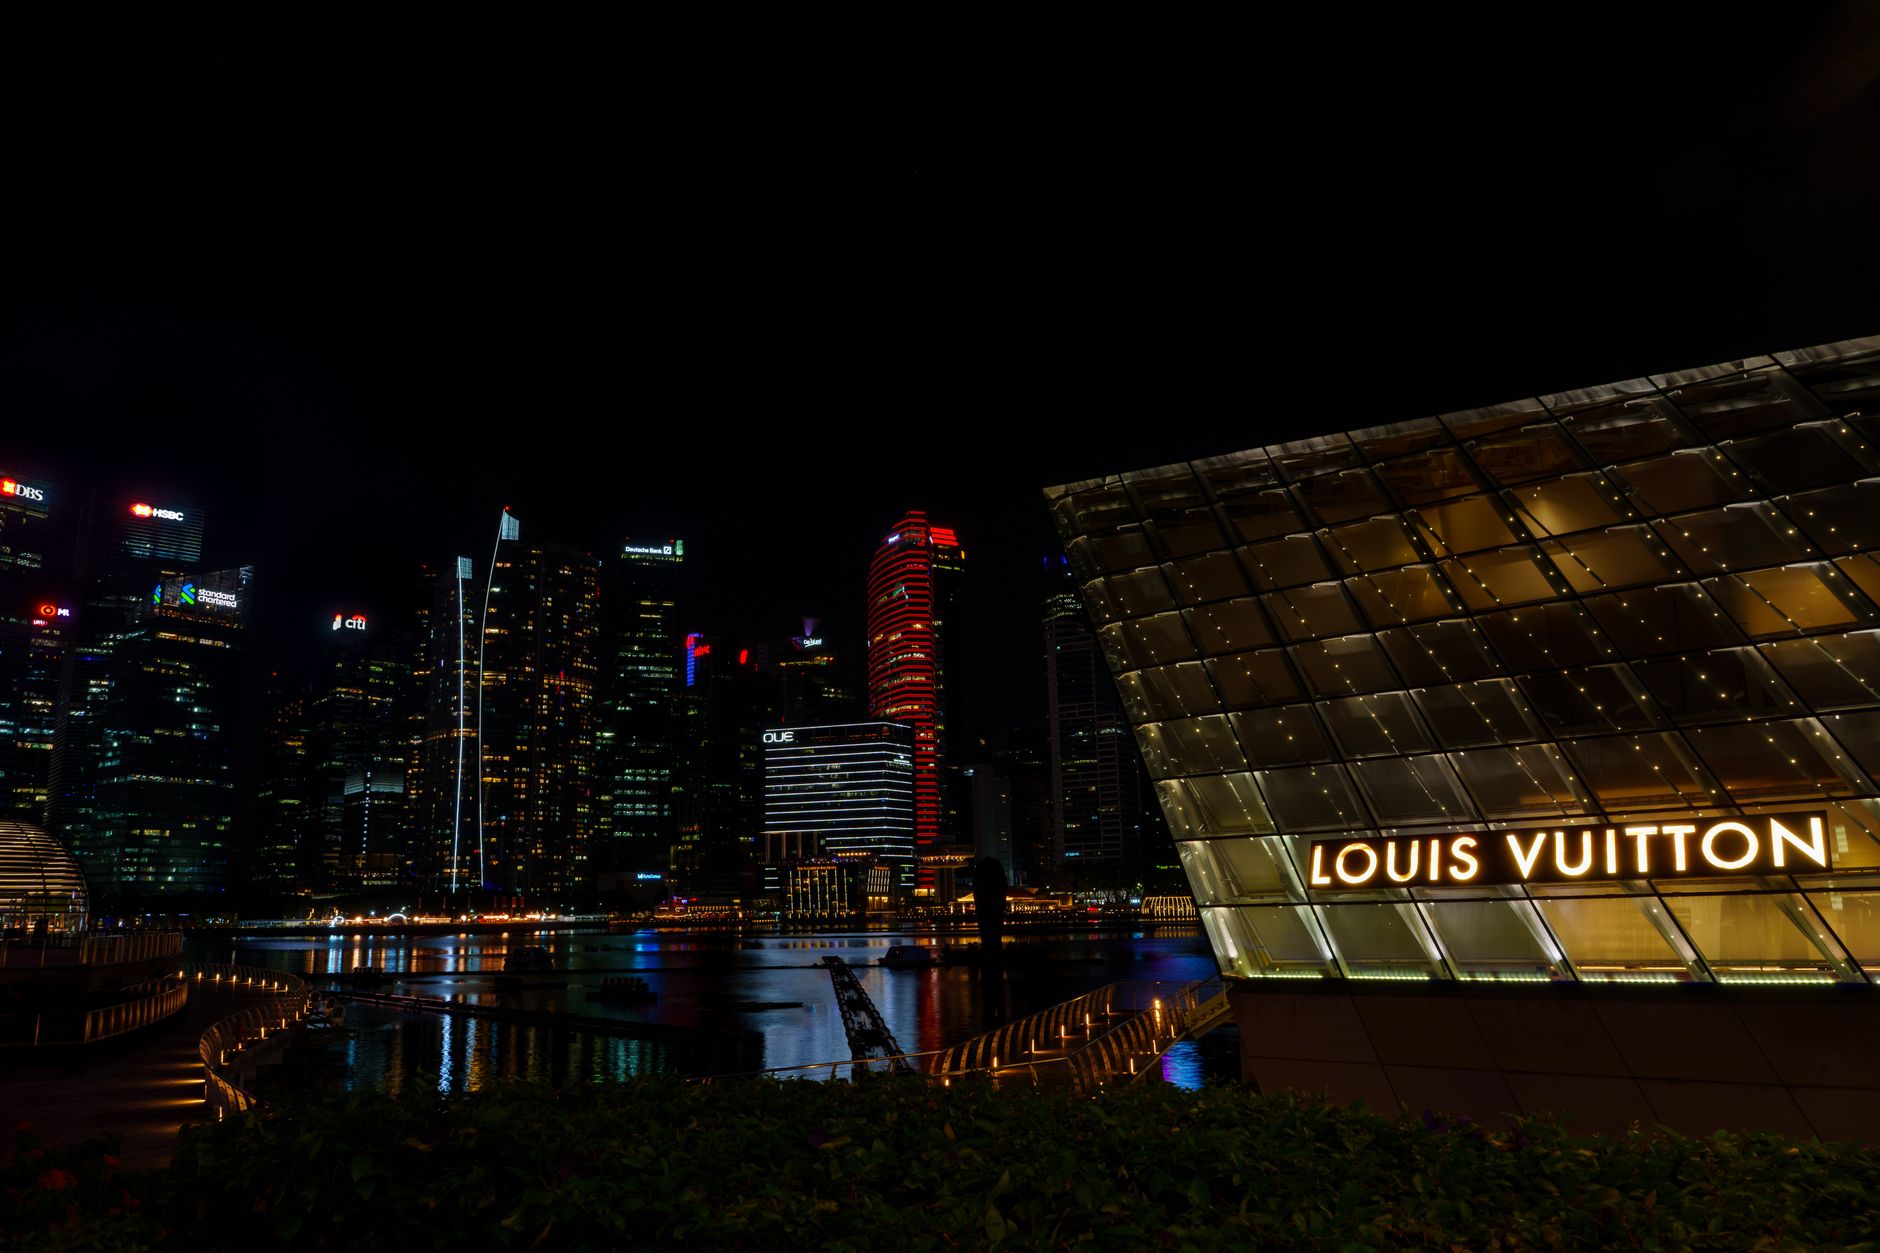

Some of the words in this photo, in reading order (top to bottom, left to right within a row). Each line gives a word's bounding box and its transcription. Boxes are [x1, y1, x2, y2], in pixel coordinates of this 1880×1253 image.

[16, 484, 44, 501] DBS
[152, 508, 184, 521] HSBC
[198, 588, 236, 601] standard
[198, 595, 237, 608] chartered
[345, 616, 366, 630] citi
[763, 731, 794, 743] OUE
[1310, 837, 1478, 885] LOUIS
[1507, 817, 1827, 879] VUITTON
